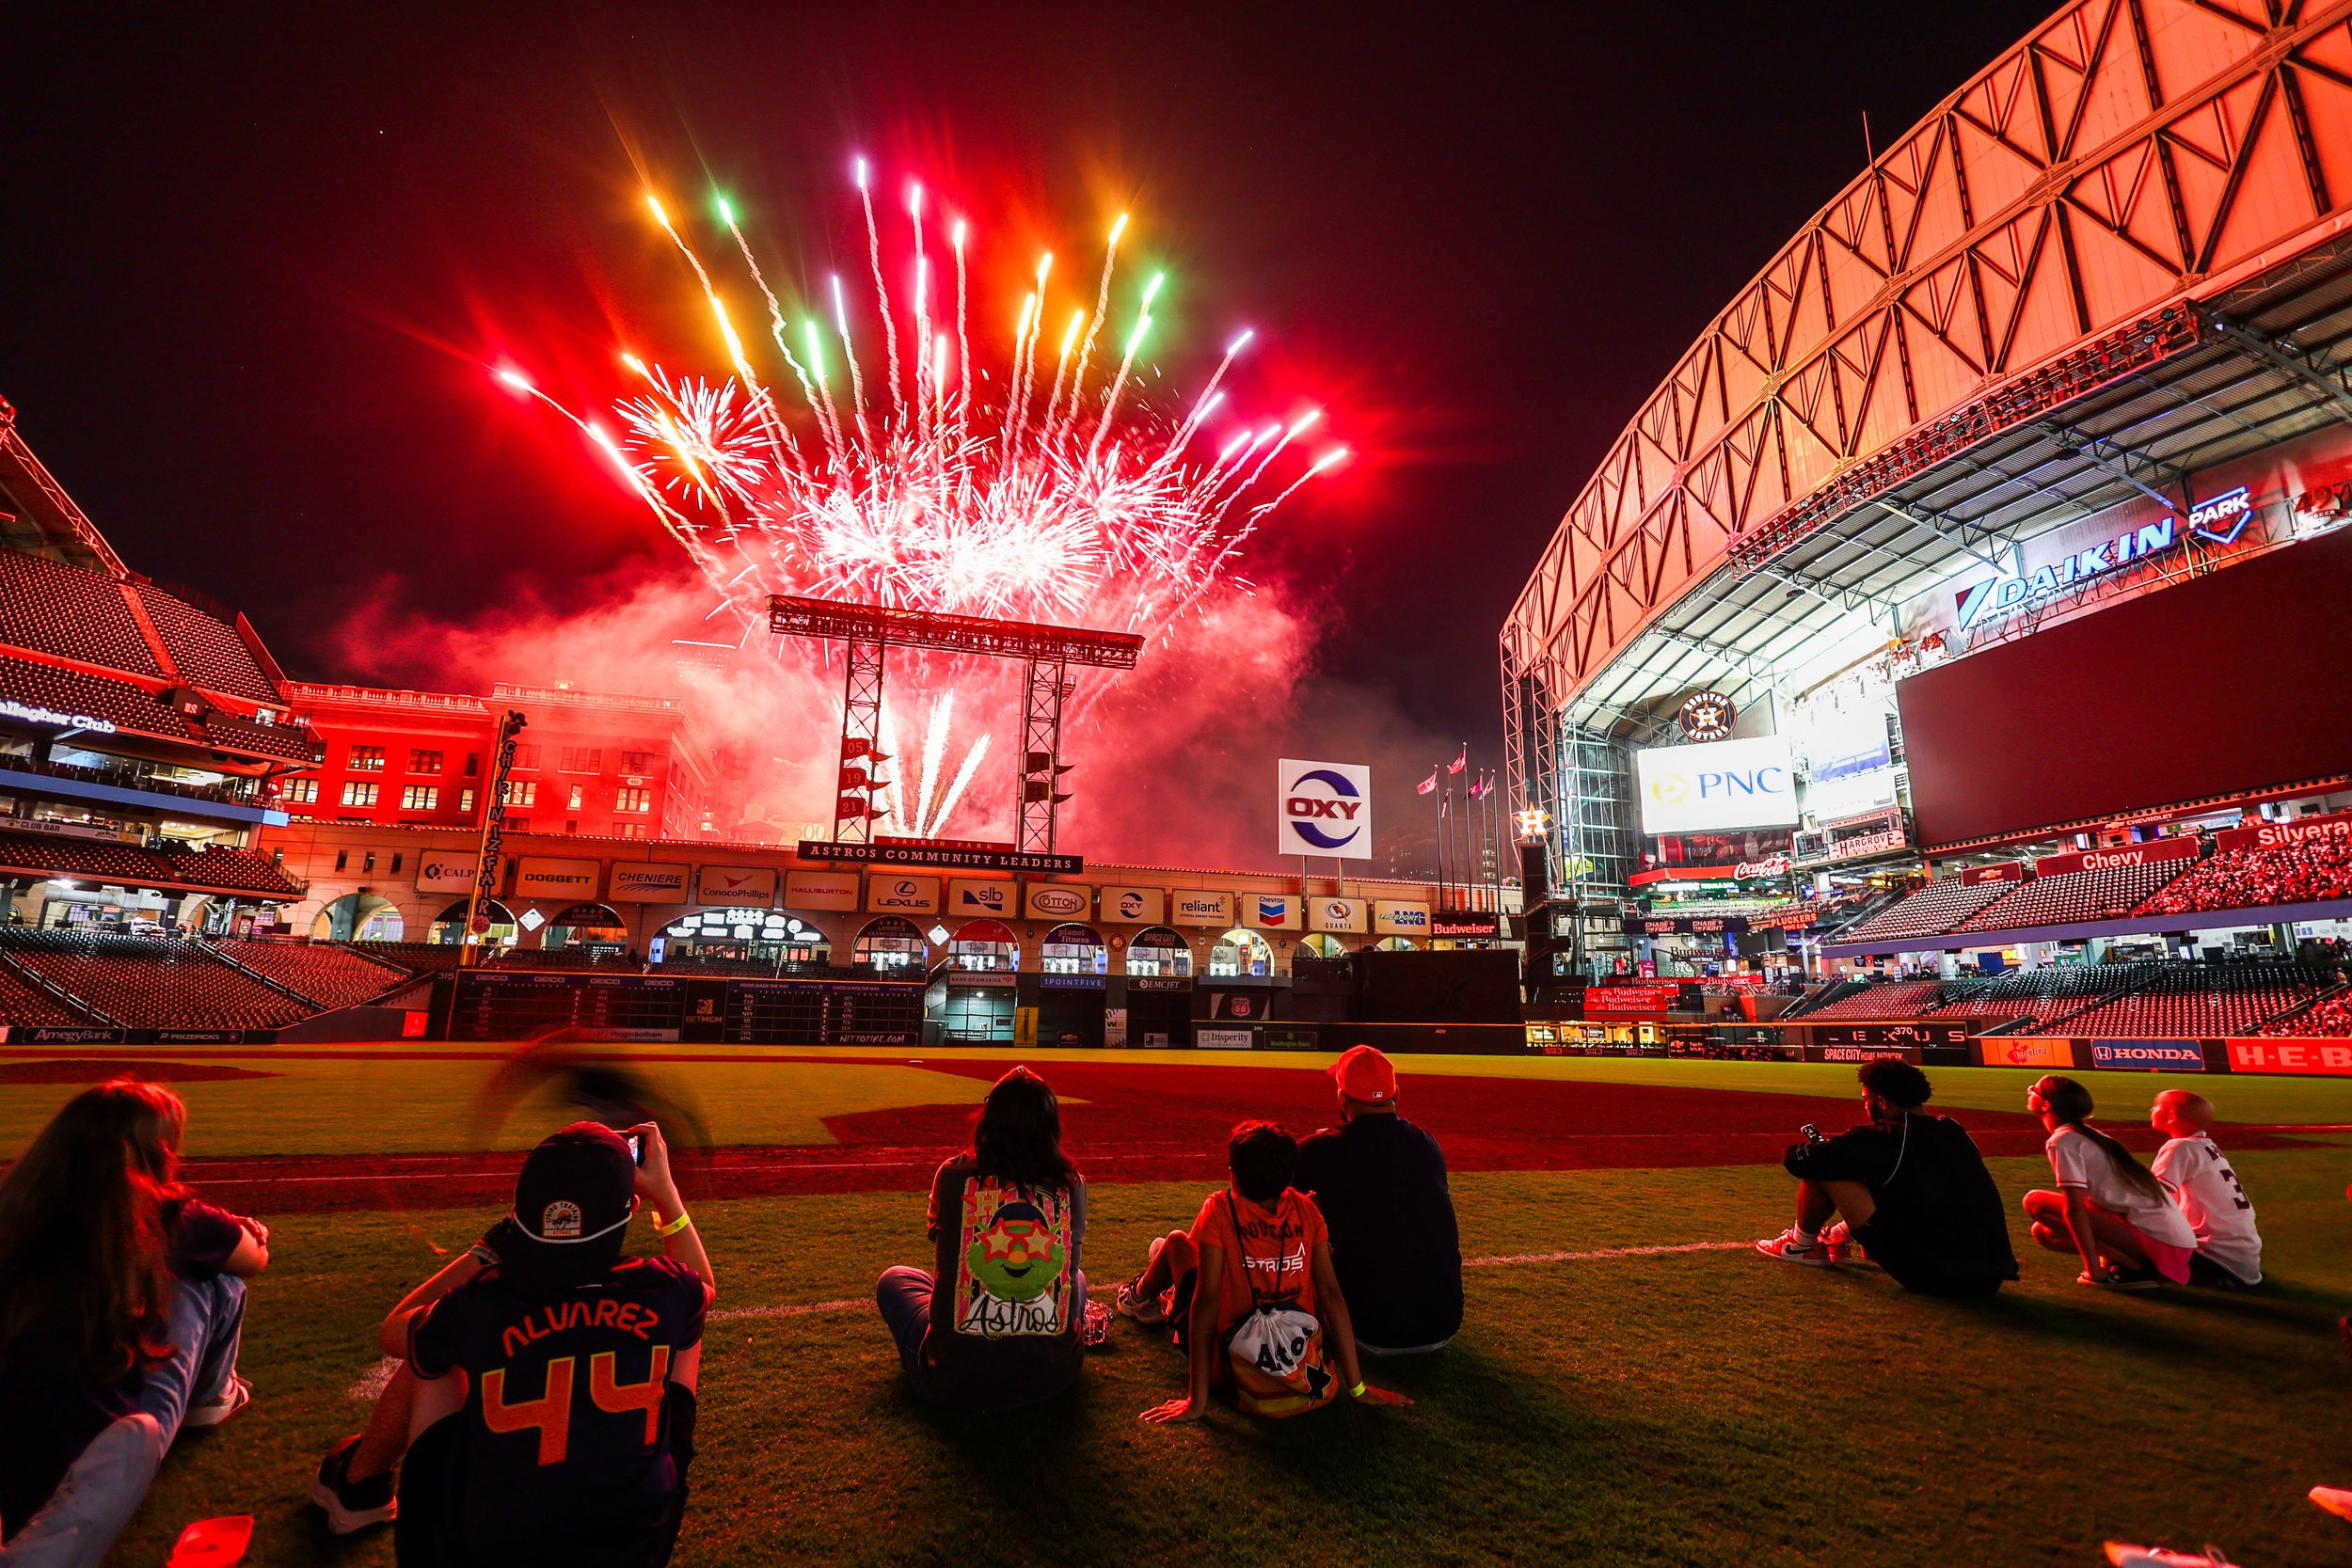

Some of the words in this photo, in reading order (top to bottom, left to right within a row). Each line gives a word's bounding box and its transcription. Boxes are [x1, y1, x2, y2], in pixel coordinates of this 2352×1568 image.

[2188, 490, 2250, 530] PARK
[1996, 515, 2175, 610] DAIKIN
[1920, 633, 1942, 652] 42
[1891, 646, 1912, 667] 34
[1684, 693, 1728, 710] HOUSTON
[1696, 707, 1718, 727] H
[72, 716, 116, 733] Club
[1689, 725, 1728, 740] ASTROS
[848, 742, 864, 753] 05
[846, 773, 861, 784] 19
[1697, 767, 1785, 799] PNC
[842, 801, 857, 813] 21
[1287, 797, 1362, 820] OXY
[2126, 813, 2172, 826] CHEVROLET
[21, 821, 42, 831] CLUB
[43, 823, 60, 832] BAR
[2258, 821, 2352, 845] Silvera
[891, 838, 946, 847] DAIKIN
[1839, 832, 1895, 855] HARGROVE
[810, 847, 876, 859] ASTROS
[885, 849, 992, 864] COMMUNITY
[1000, 856, 1072, 868] LEADERS
[2082, 851, 2143, 870] Chevy
[524, 873, 592, 884] DOGGETT
[617, 872, 684, 884] CHENIERE
[703, 888, 770, 899] ConocoPhillips
[791, 887, 853, 895] HALLIBURTON
[978, 886, 1004, 902] slb
[877, 897, 930, 908] LEXUS
[1039, 895, 1078, 911] COTTON
[1120, 901, 1142, 910] OXY
[1181, 901, 1221, 913] reliant
[1393, 910, 1426, 926] LNG
[1771, 913, 1818, 927] PLUCKERS
[1058, 928, 1085, 938] planet
[1433, 923, 1495, 935] Budweiser
[1061, 935, 1089, 943] fitness
[1670, 945, 1731, 957] Budweiser
[1043, 978, 1103, 987] 1POINTFIVE
[1148, 980, 1181, 990] EMCJET
[1708, 975, 1750, 985] Budweiser
[1613, 988, 1662, 996] Budweiser
[1601, 995, 1651, 1004] Budweiser
[1233, 1005, 1247, 1013] 66
[1608, 1003, 1657, 1011] Budweiser
[820, 996, 829, 1041] AMERICAN
[34, 1028, 112, 1042] AmegyBank
[1211, 1033, 1249, 1042] Insperity
[1894, 1027, 1913, 1036] 370
[839, 1034, 905, 1043] NITTOTIRE.COM
[1824, 1048, 1845, 1060] SPACE
[1846, 1049, 1861, 1060] CITY
[1861, 1052, 1876, 1060] HOME
[2012, 1046, 2047, 1059] Valentina
[2114, 1047, 2201, 1060] HONDA
[2235, 1045, 2352, 1068] H-E-B
[975, 1190, 1001, 1221] H
[959, 1294, 1064, 1338] Astros
[501, 1299, 660, 1357] ALVAREZ
[482, 1345, 670, 1466] 44
